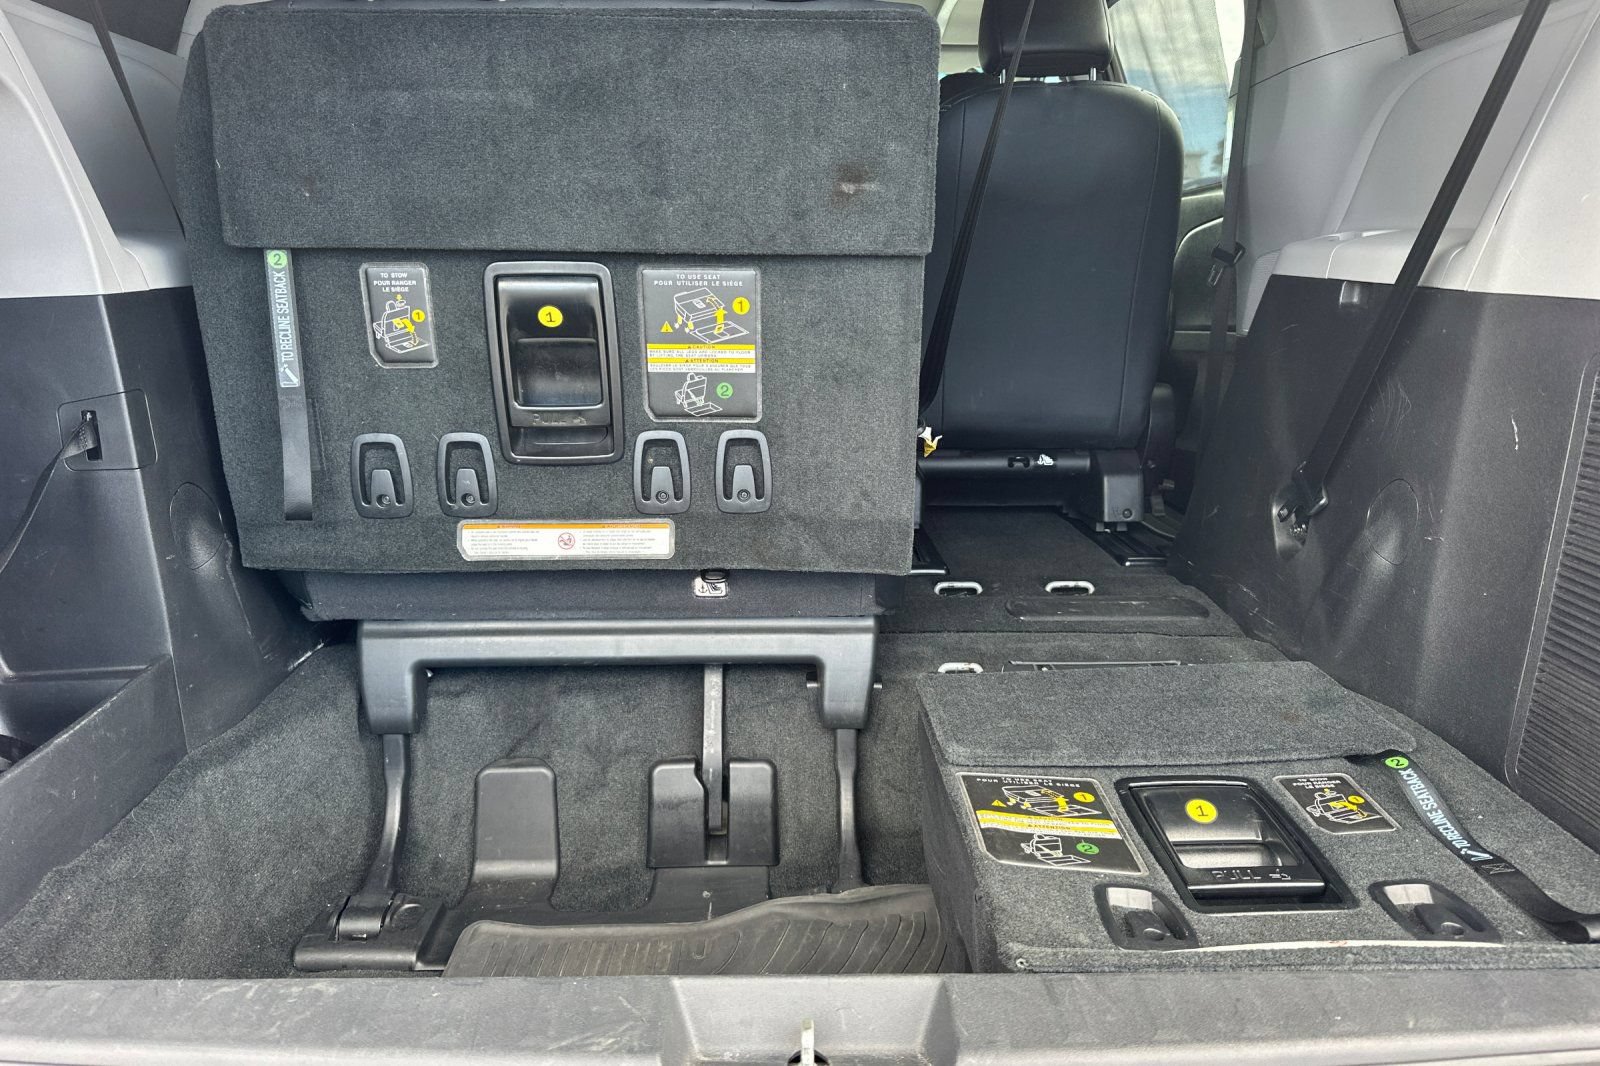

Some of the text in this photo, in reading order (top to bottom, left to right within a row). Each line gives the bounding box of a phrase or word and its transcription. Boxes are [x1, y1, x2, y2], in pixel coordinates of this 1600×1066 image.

[273, 253, 283, 266] 2
[272, 270, 294, 362] TO RECLINE SEATBACK
[1195, 805, 1209, 817] 1
[1398, 767, 1471, 849] TO RECLINE SEATBACK
